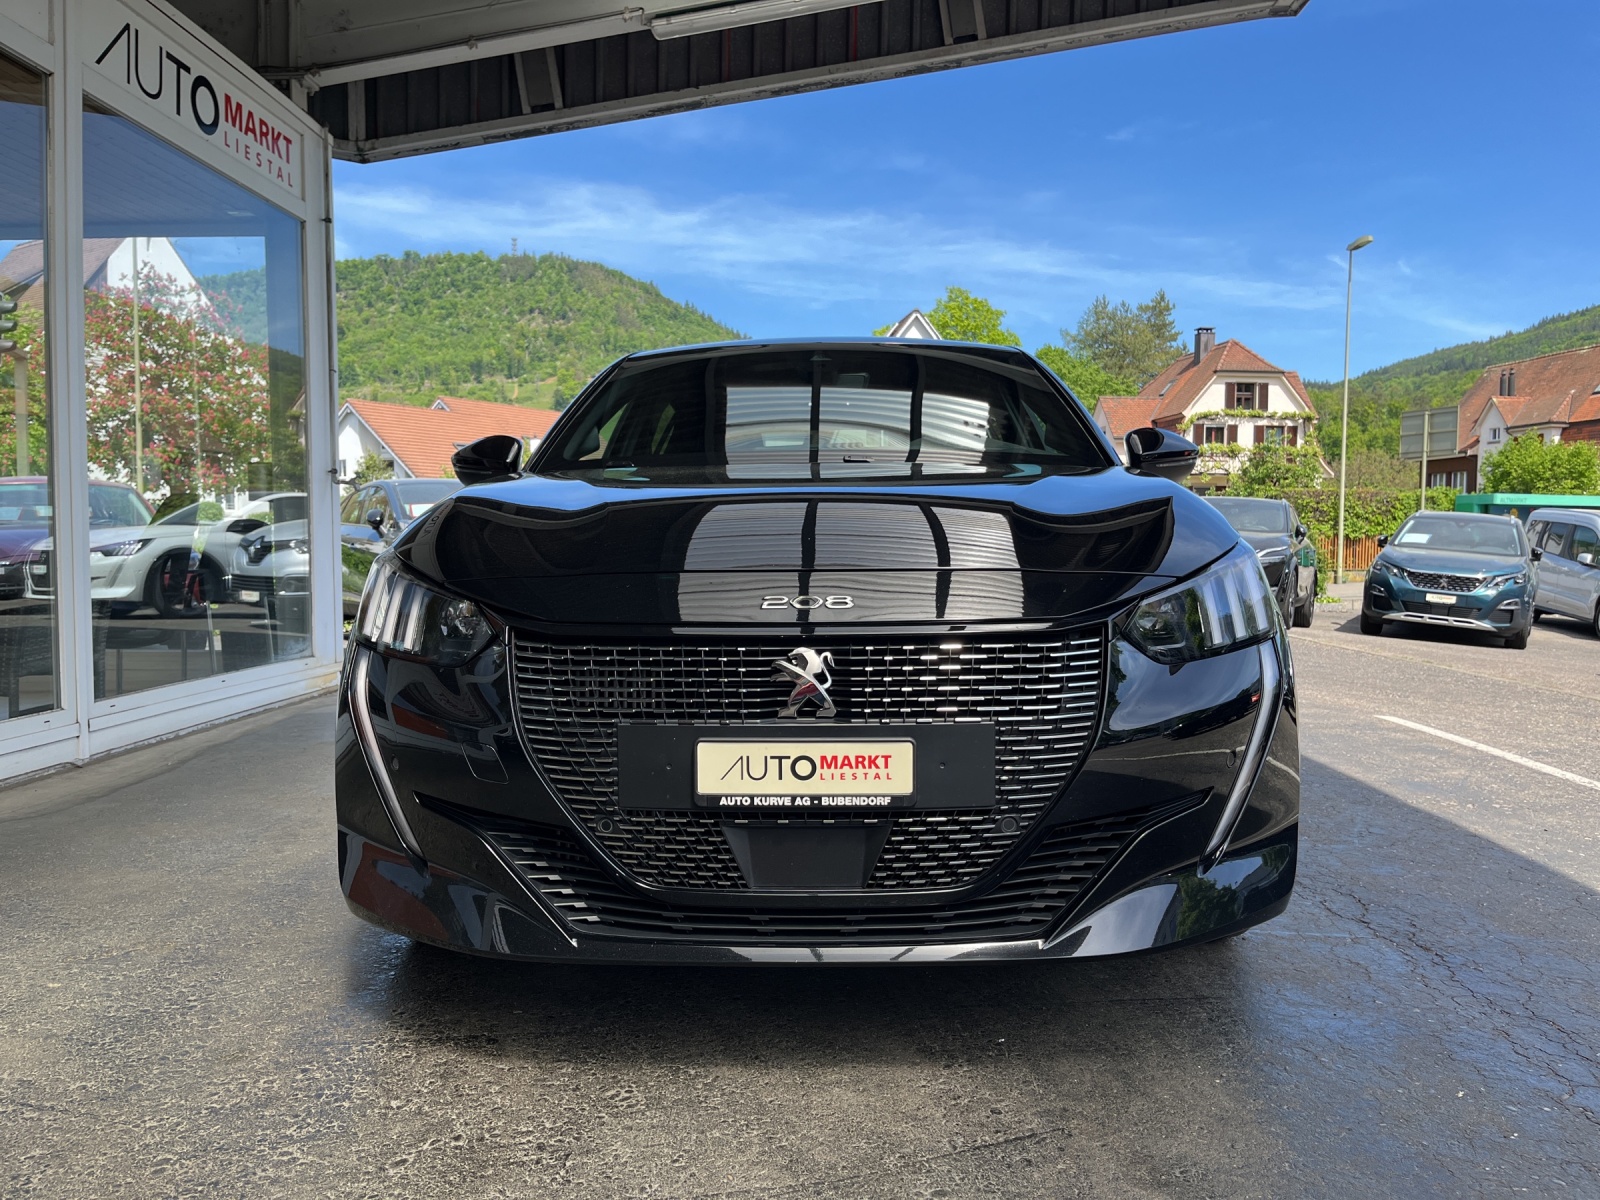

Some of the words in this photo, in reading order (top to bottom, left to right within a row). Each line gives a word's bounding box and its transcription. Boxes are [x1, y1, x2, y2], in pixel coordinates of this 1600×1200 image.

[95, 22, 220, 136] AUTO
[224, 93, 293, 165] MARKT
[224, 131, 293, 189] LIESTAL
[760, 595, 855, 609] 208
[720, 754, 817, 781] AUTO
[820, 755, 892, 769] MARKT
[820, 772, 892, 780] LIESTAL
[719, 796, 750, 806] AUTO
[754, 796, 791, 806] KURVE
[794, 796, 811, 806] AG
[822, 796, 891, 806] BUBENDORF
